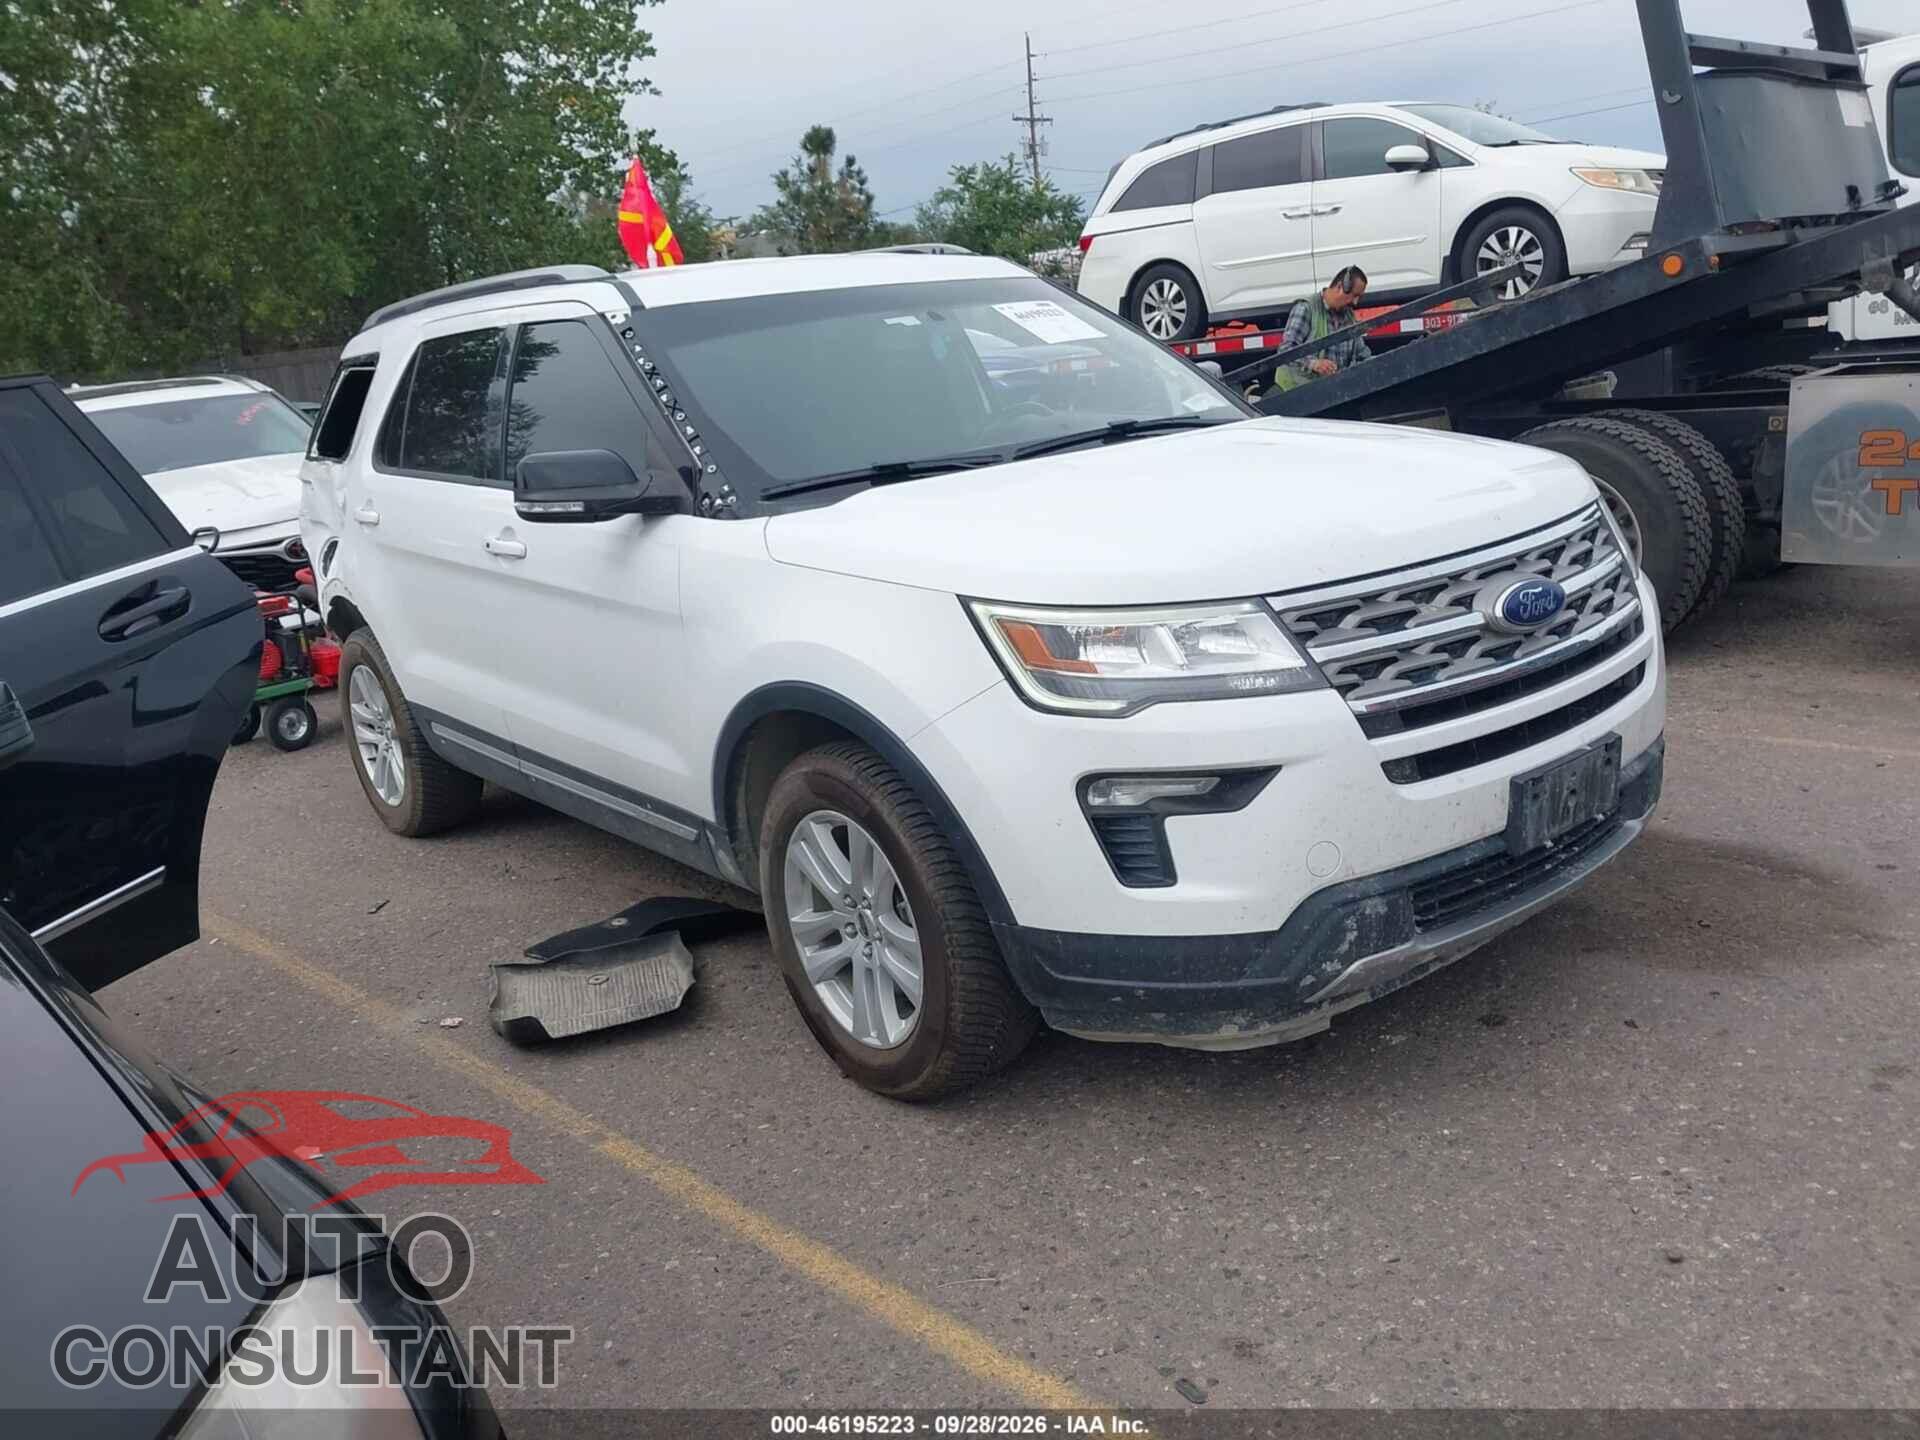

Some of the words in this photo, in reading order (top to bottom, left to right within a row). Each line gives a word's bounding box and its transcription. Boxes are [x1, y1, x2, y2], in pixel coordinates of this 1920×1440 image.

[1857, 429, 1920, 468] 2
[1871, 479, 1920, 516] T
[1519, 586, 1557, 619] Ford
